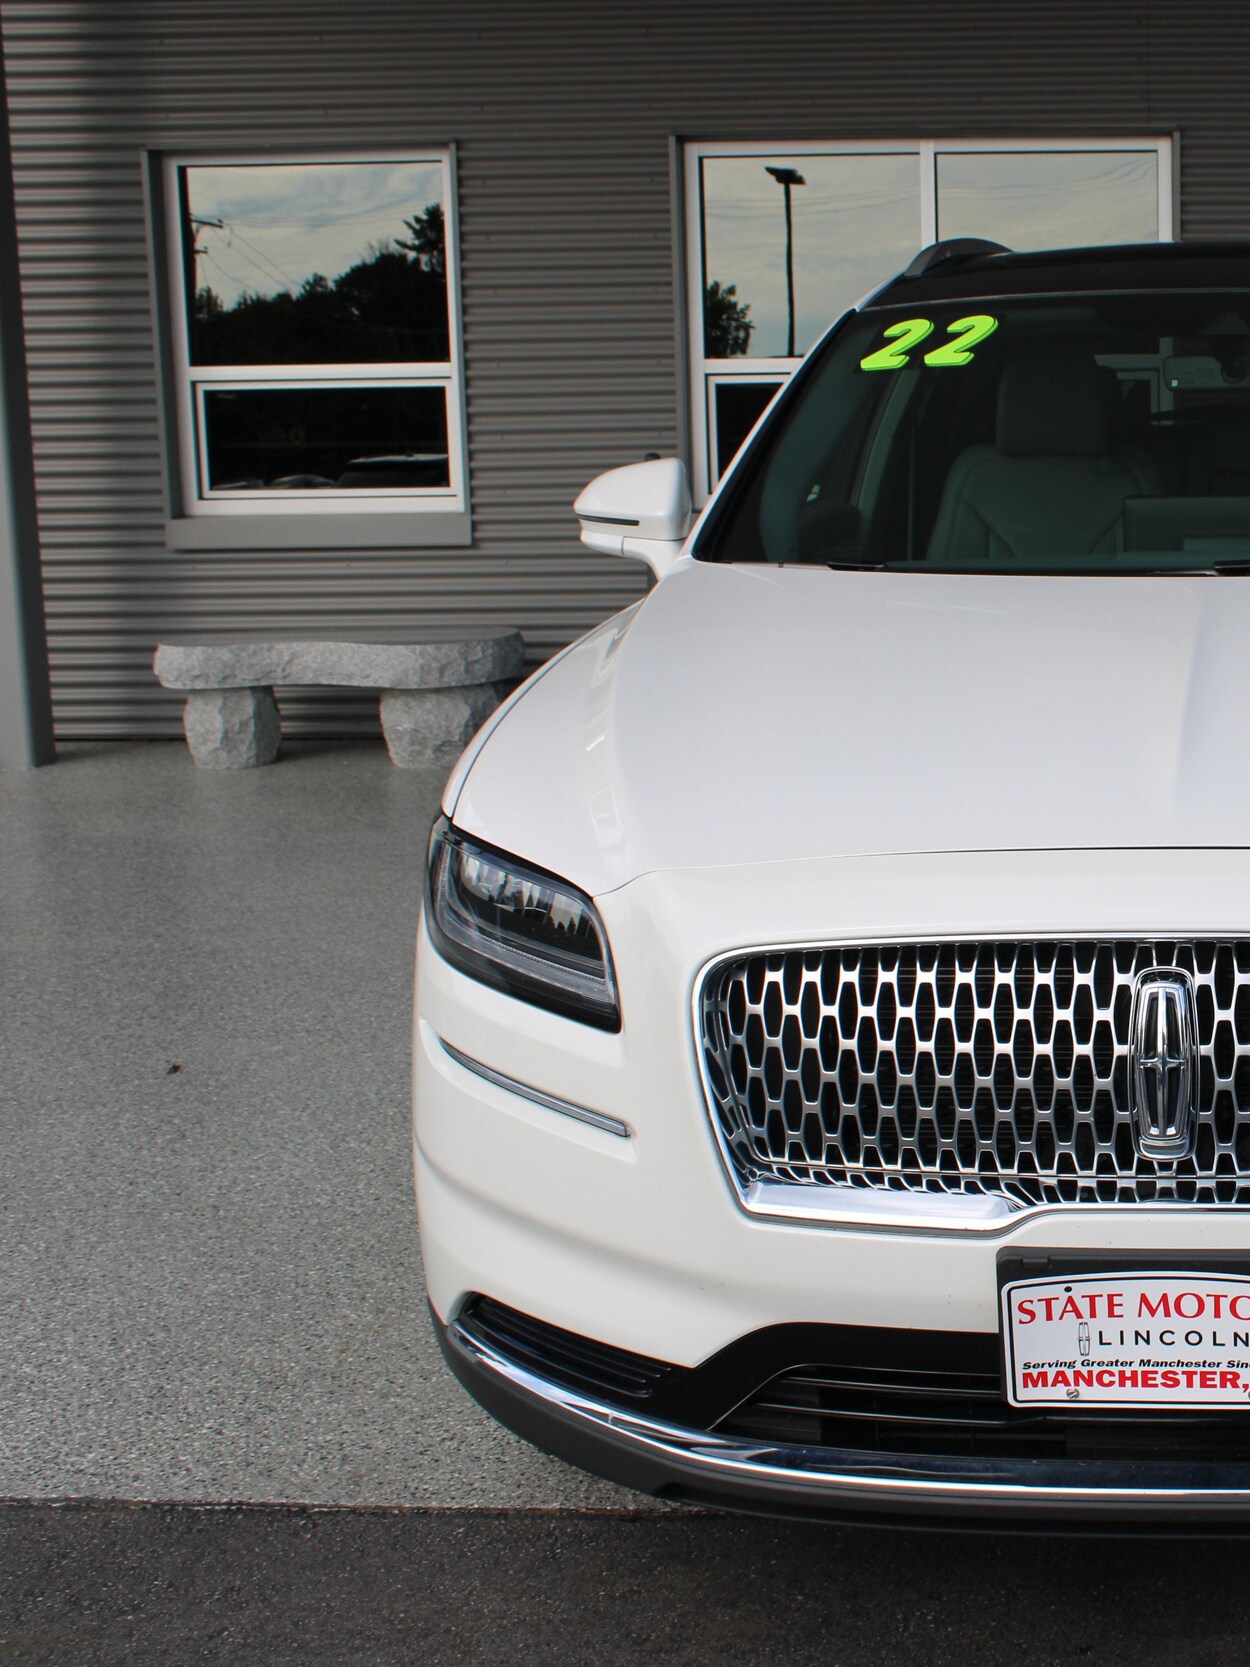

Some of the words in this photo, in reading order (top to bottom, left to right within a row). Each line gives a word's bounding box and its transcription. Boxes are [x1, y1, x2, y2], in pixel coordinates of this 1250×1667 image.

[860, 314, 999, 371] 22
[1017, 1293, 1125, 1325] STATE
[1098, 1329, 1250, 1348] LINCOLN
[1022, 1358, 1077, 1370] Serving
[1080, 1358, 1135, 1368] Greater
[1138, 1358, 1223, 1369] Manchester
[1022, 1369, 1250, 1393] MANCHESTER,
